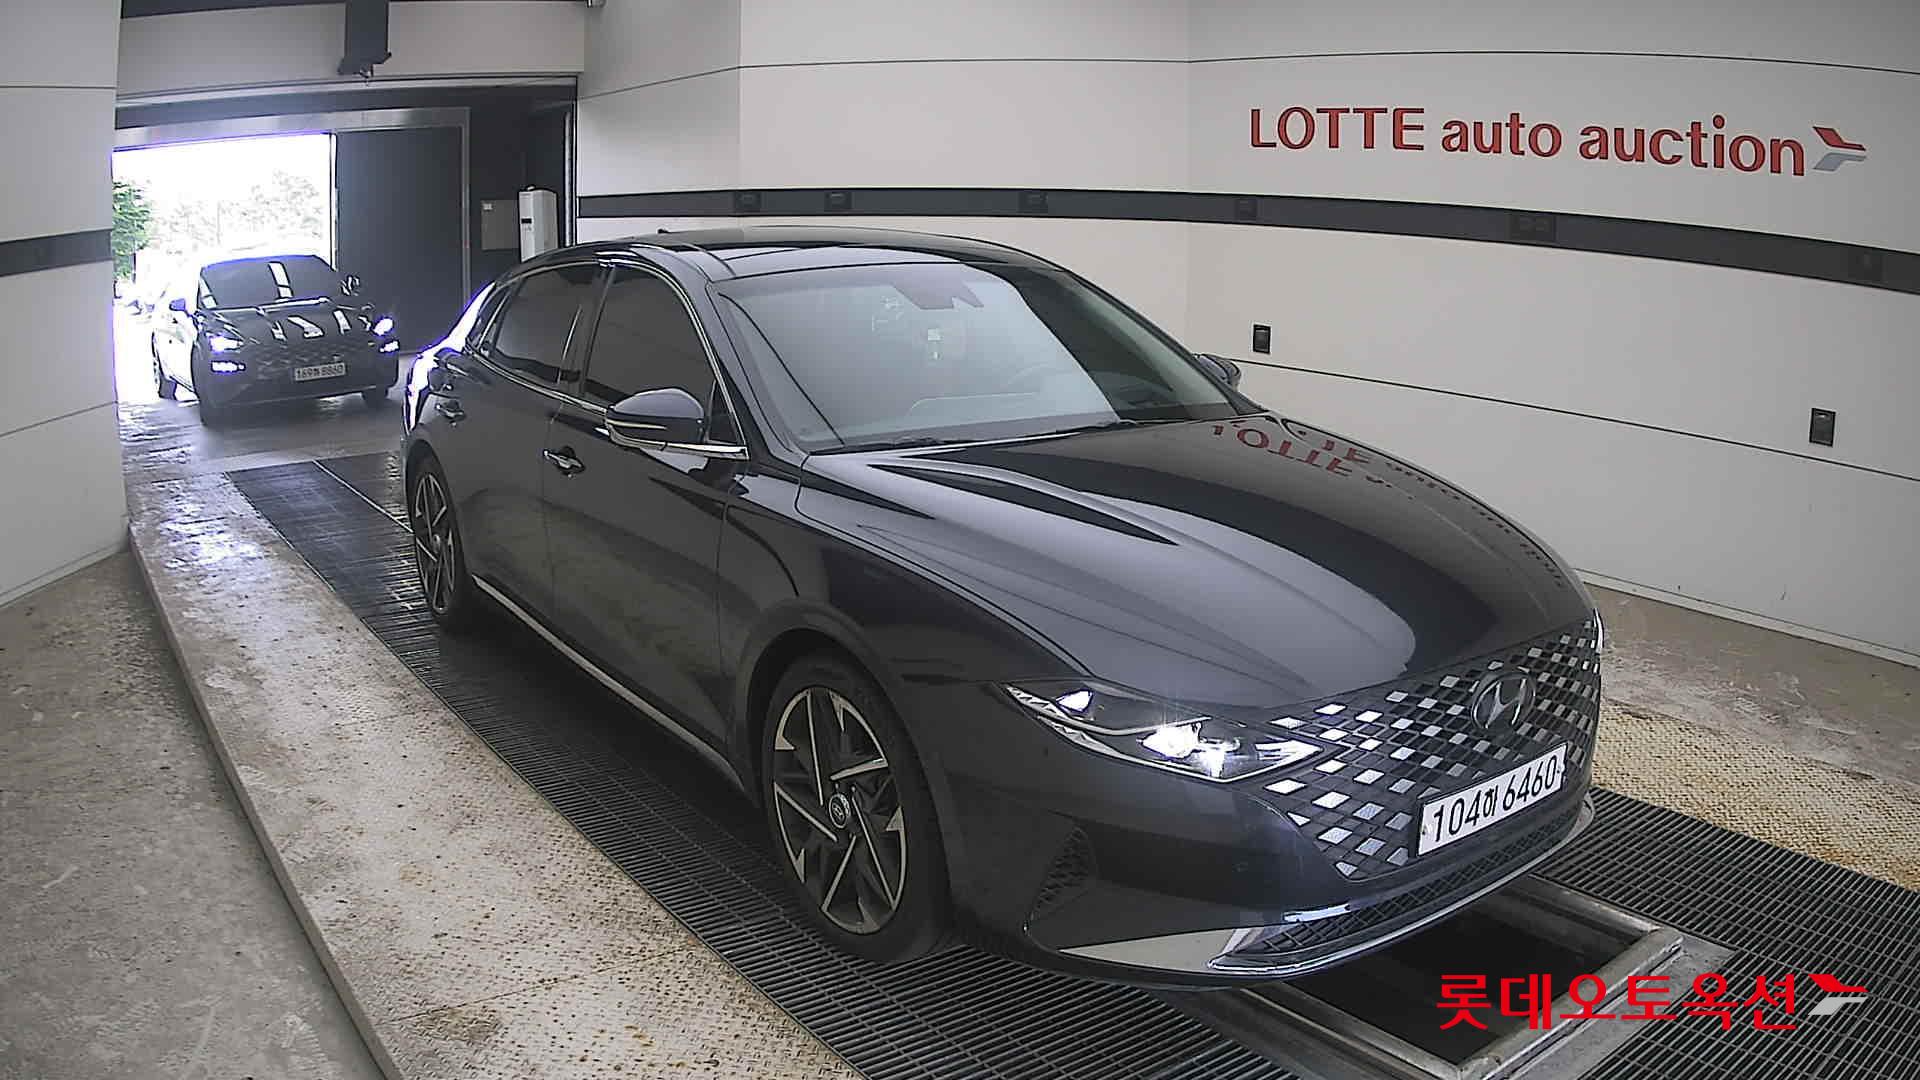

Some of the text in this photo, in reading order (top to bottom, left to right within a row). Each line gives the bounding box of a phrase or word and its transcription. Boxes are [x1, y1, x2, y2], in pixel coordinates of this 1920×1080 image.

[1251, 107, 1804, 176] LOTTE auto auction
[1502, 755, 1558, 811] 6460
